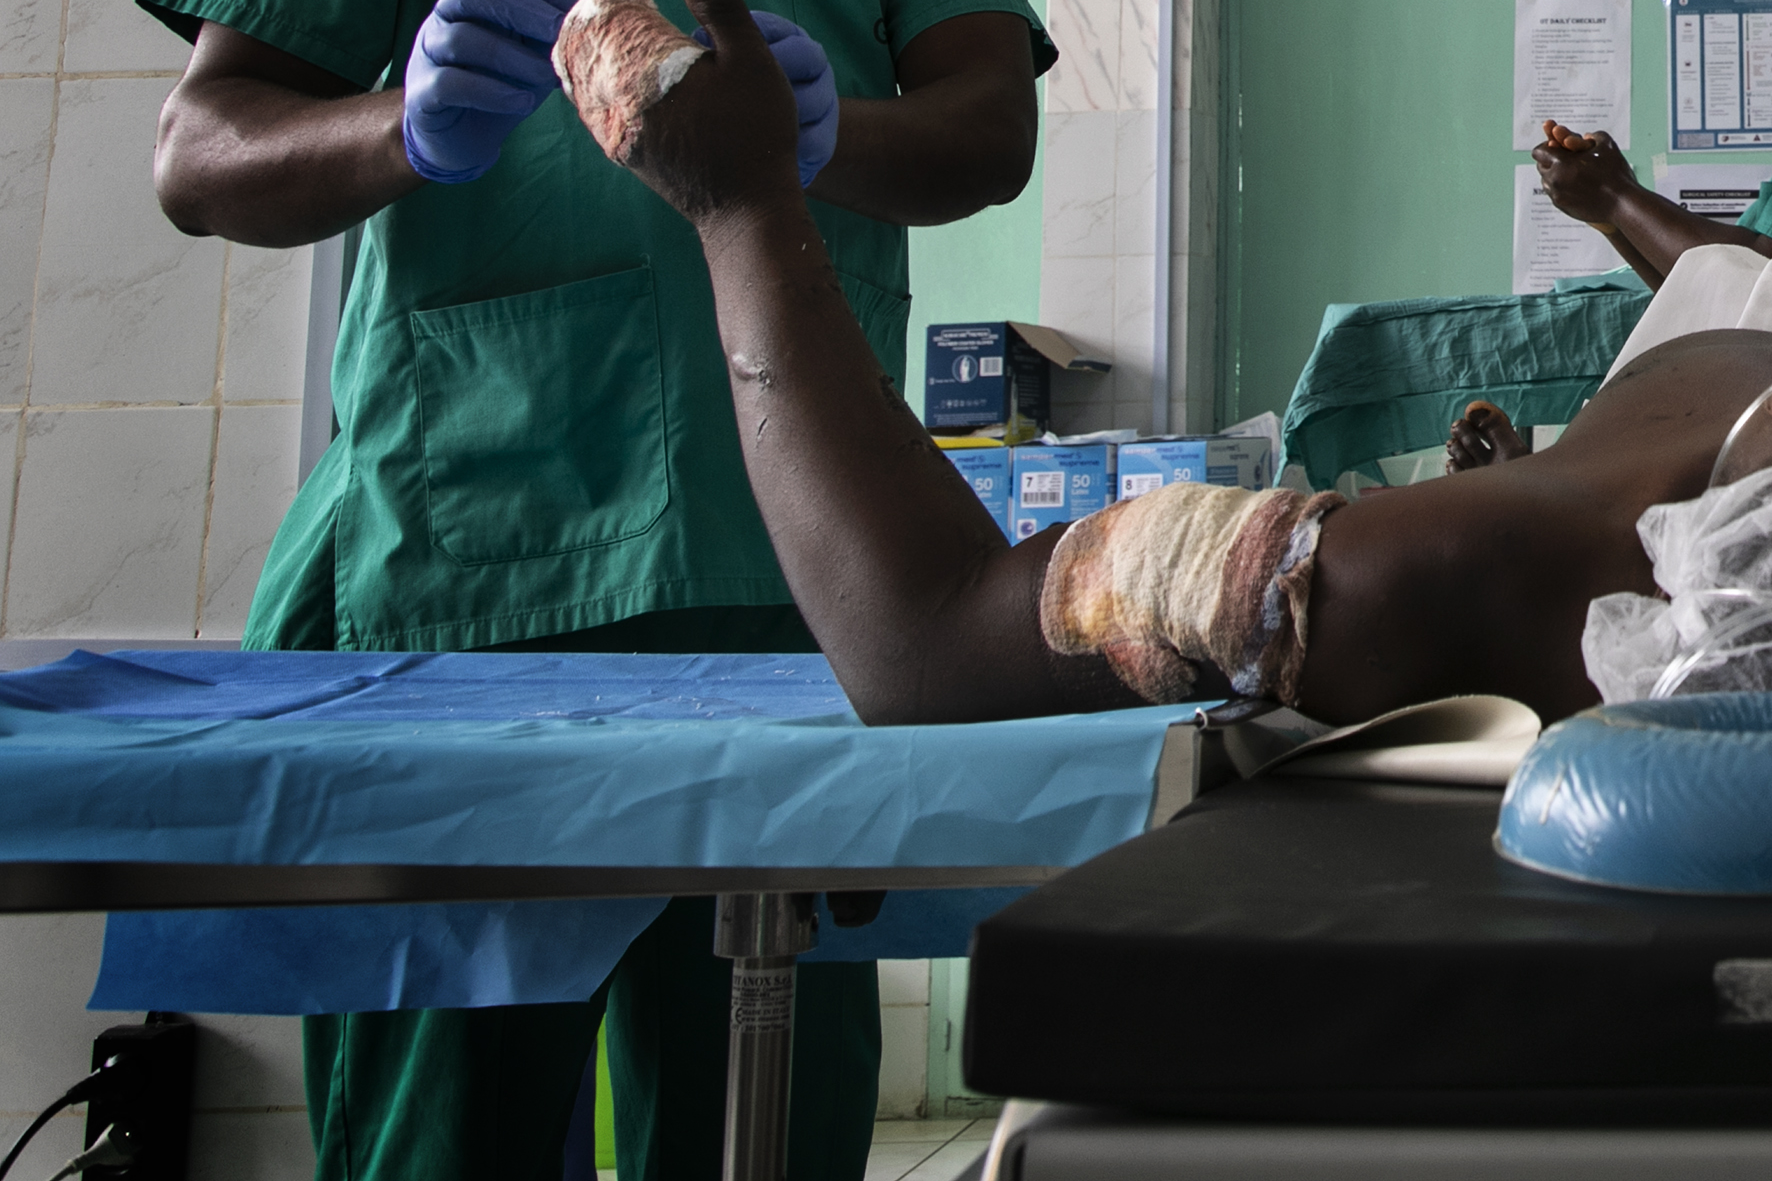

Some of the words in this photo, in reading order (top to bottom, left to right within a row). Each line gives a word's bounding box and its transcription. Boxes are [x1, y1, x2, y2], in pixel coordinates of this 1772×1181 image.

[1072, 474, 1091, 488] 50
[1173, 468, 1191, 481] 50
[974, 477, 993, 491] 50
[1026, 476, 1033, 488] 7
[1125, 479, 1132, 490] 8
